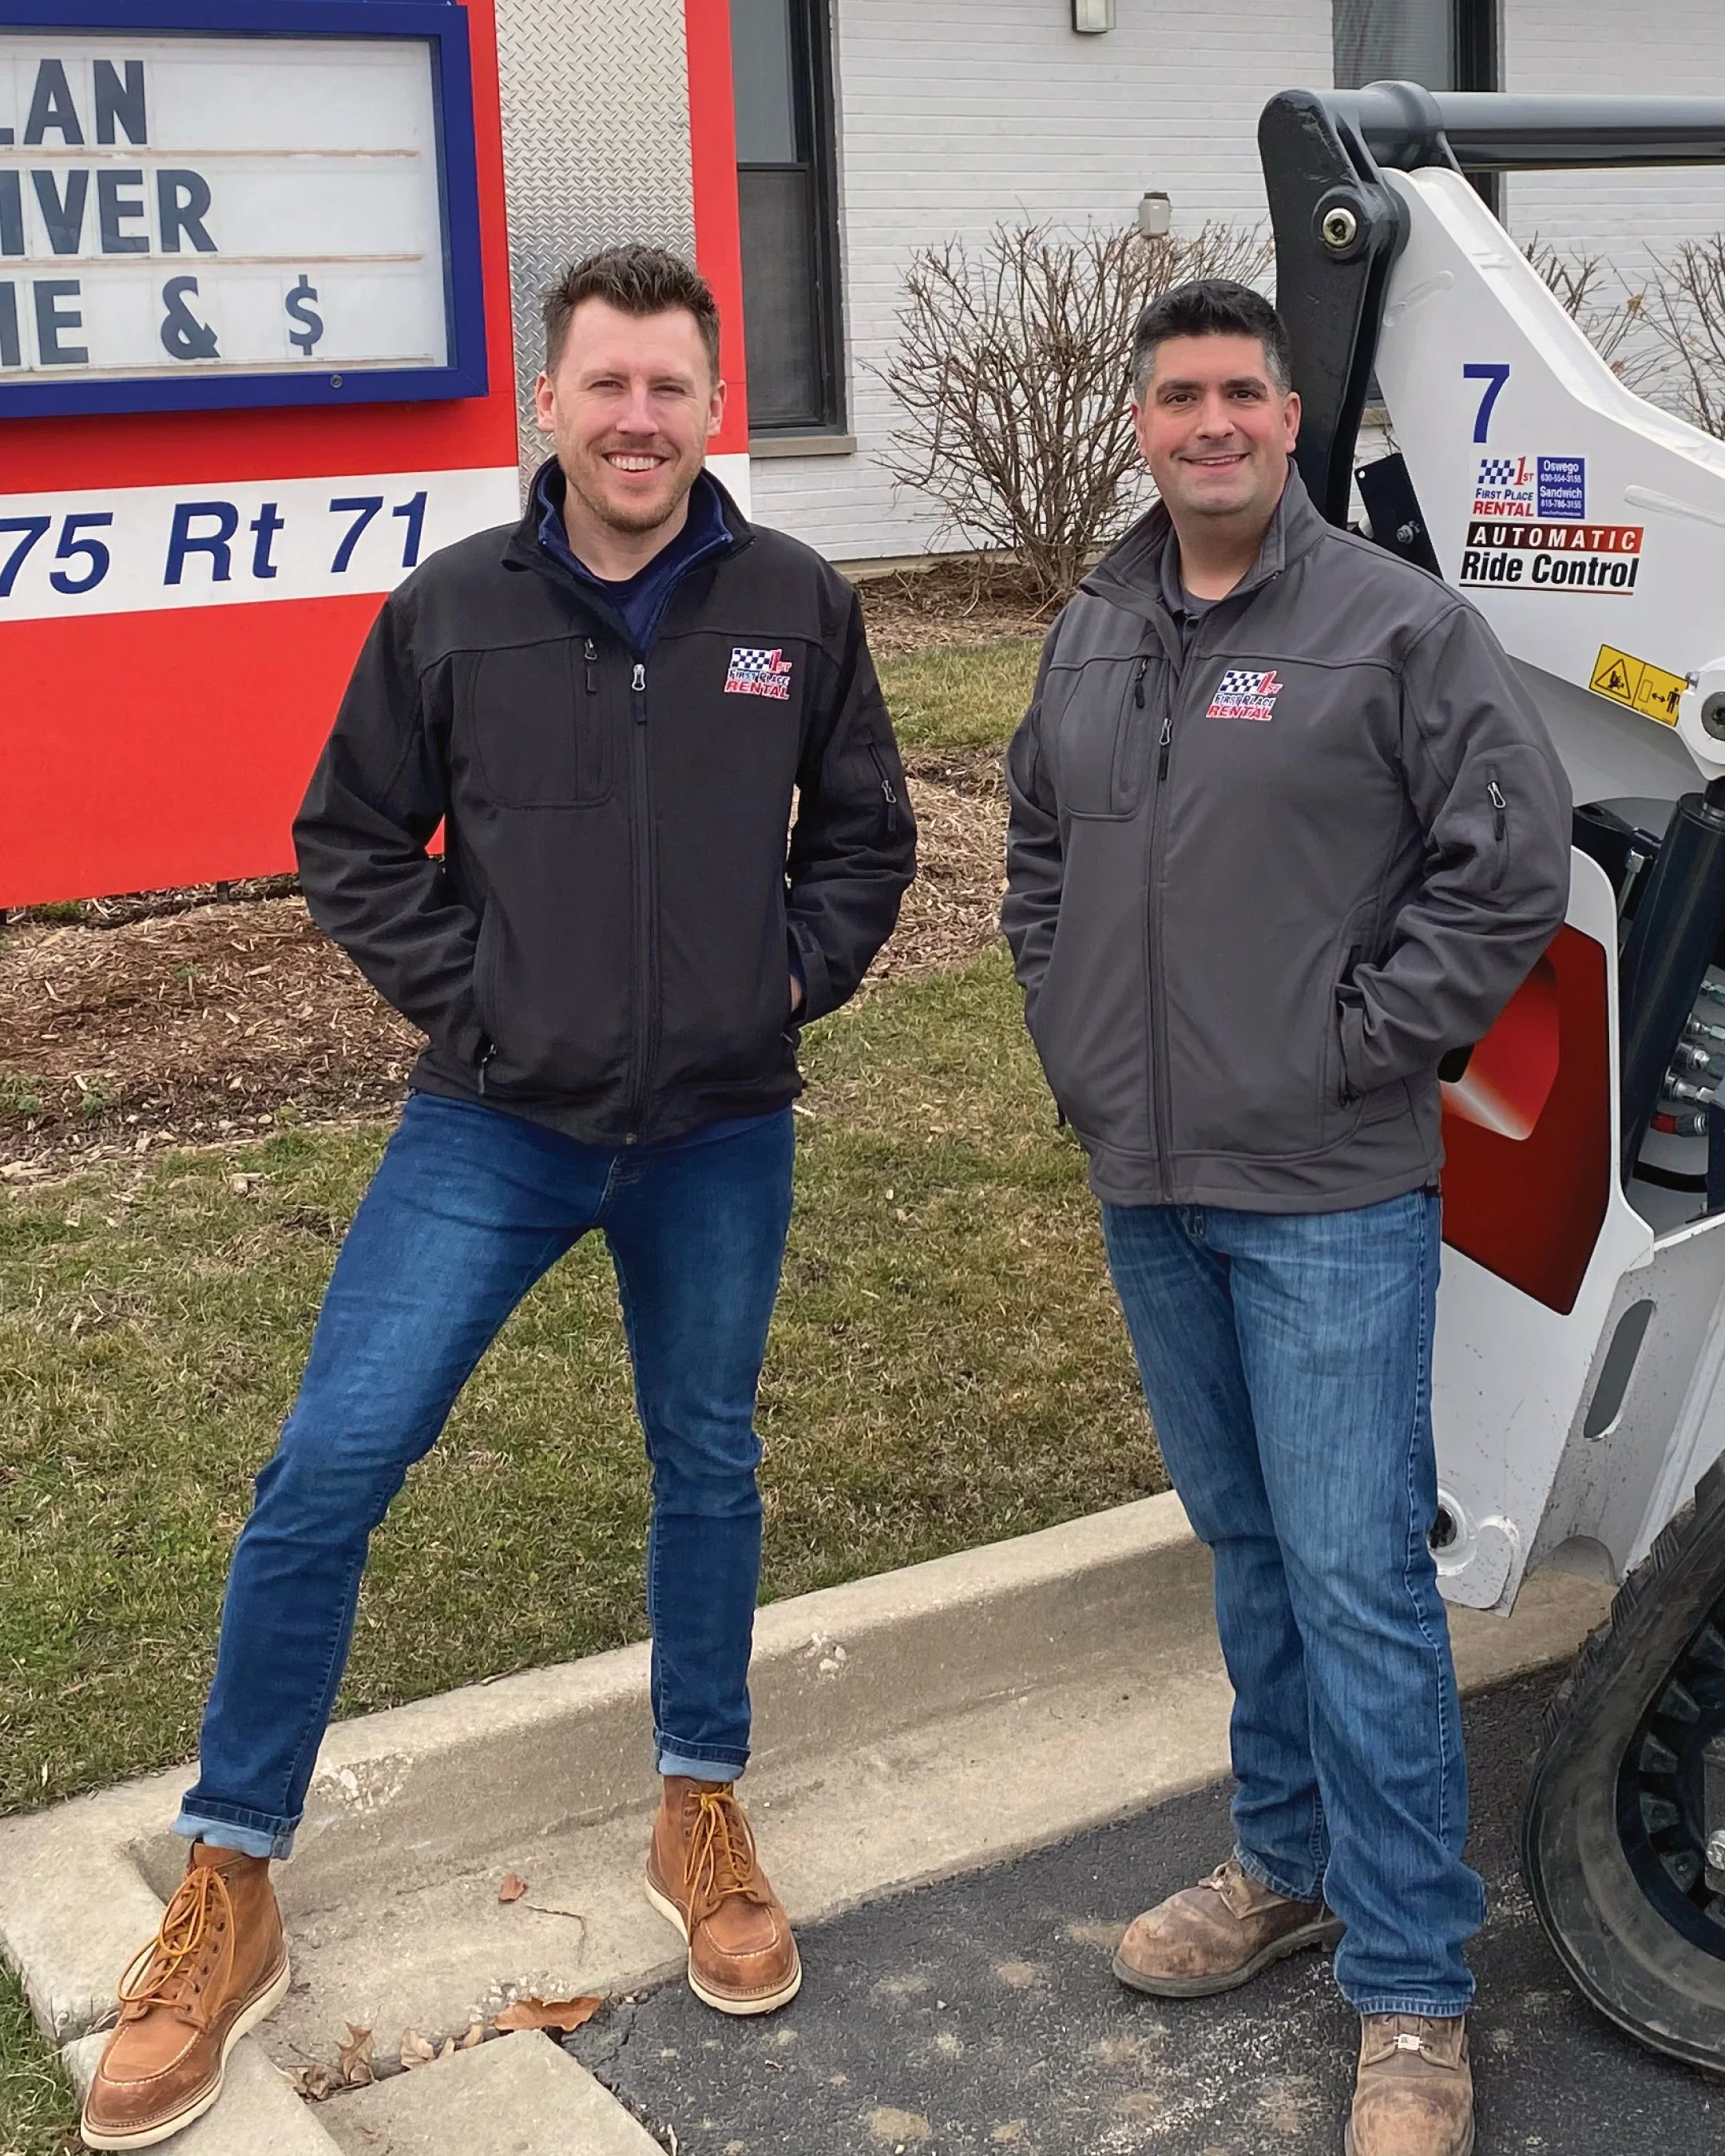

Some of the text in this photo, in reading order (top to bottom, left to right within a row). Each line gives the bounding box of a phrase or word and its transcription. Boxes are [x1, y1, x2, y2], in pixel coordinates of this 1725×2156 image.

[0, 59, 147, 144] AN
[161, 276, 221, 359] &
[285, 275, 323, 355] $
[1463, 364, 1510, 443] 7
[1544, 460, 1579, 474] Oswego
[1476, 488, 1533, 501] FIRST PLACE
[1540, 485, 1582, 498] Sandwich
[1473, 501, 1534, 517] RENTAL
[0, 491, 427, 597] 75 Rt 71
[1473, 526, 1636, 549] AUTOMATIC
[1460, 551, 1640, 587] Ride Control
[725, 680, 789, 700] RENTAL
[1207, 705, 1272, 720] RENTAL
